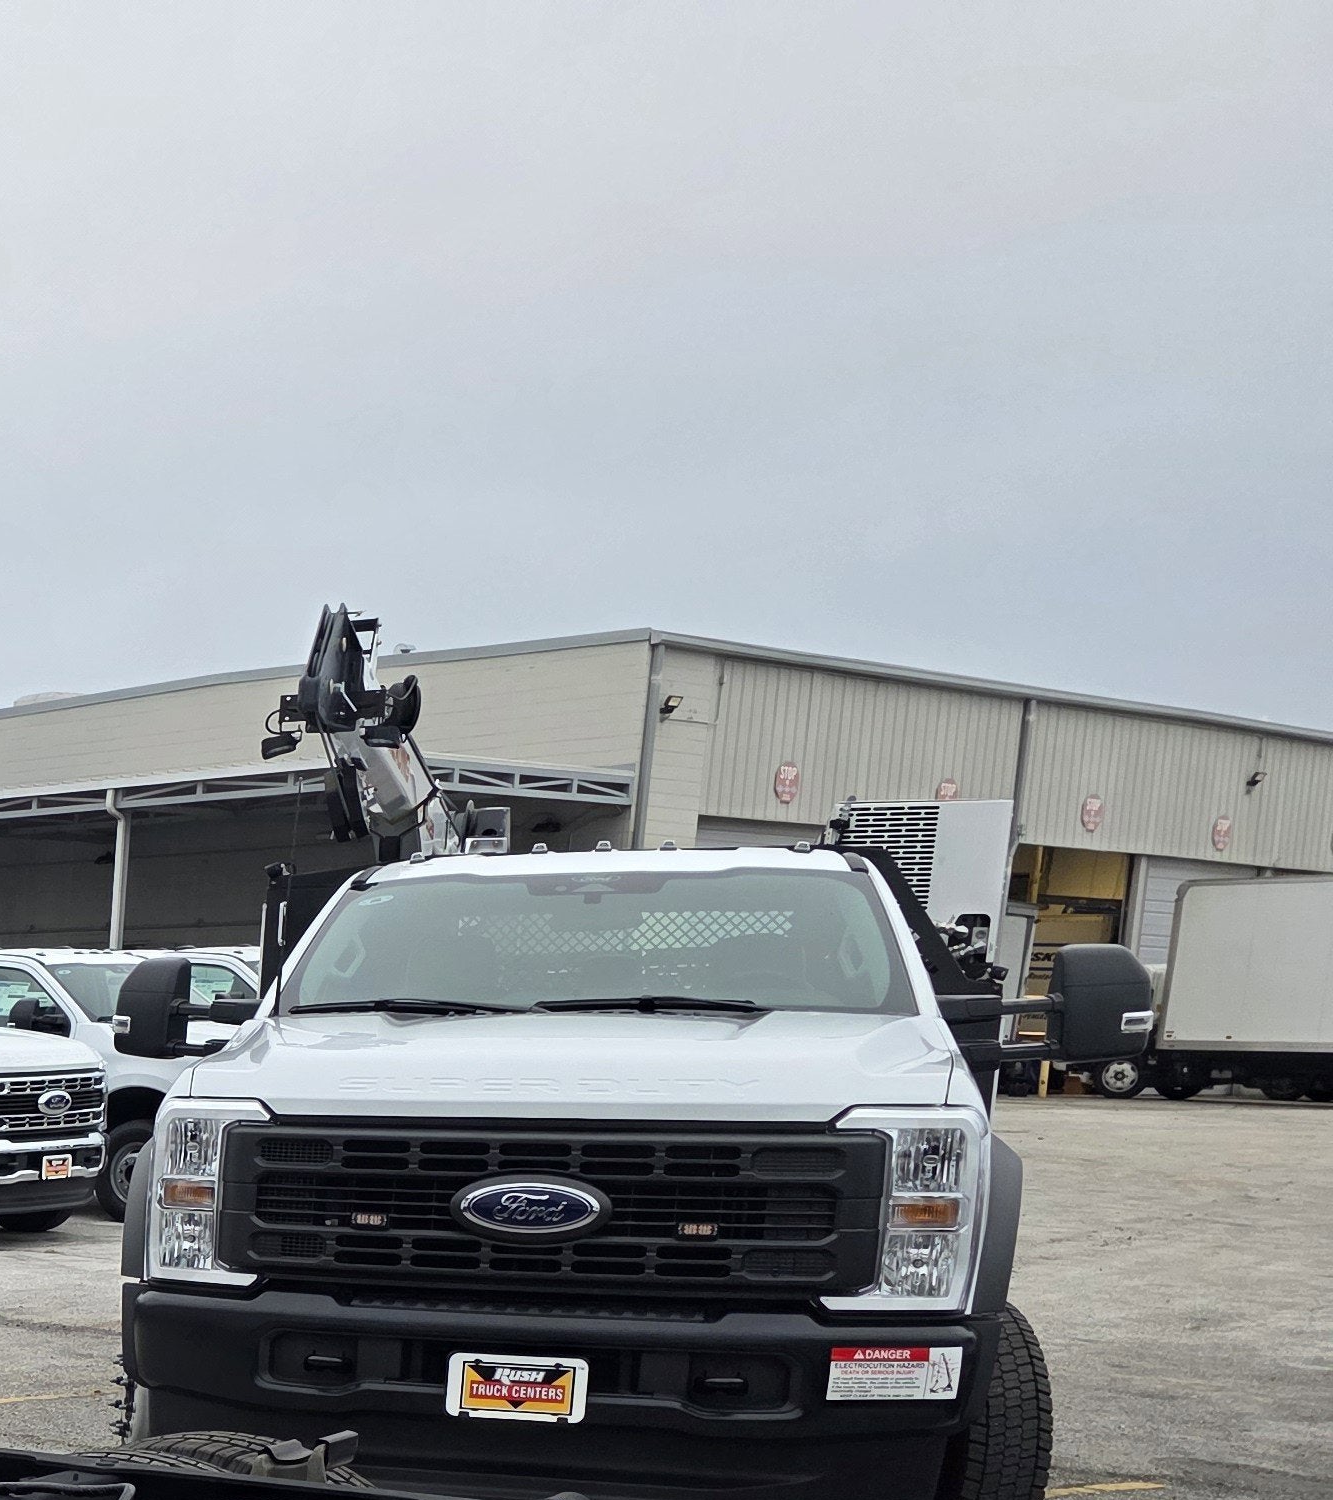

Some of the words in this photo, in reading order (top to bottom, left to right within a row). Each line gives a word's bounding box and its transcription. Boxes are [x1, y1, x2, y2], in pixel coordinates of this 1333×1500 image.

[780, 766, 797, 779] STOP
[493, 1192, 568, 1222] Ford
[865, 1349, 911, 1360] DANGER
[471, 1383, 509, 1398] TRUCK
[511, 1385, 564, 1401] CENTERS
